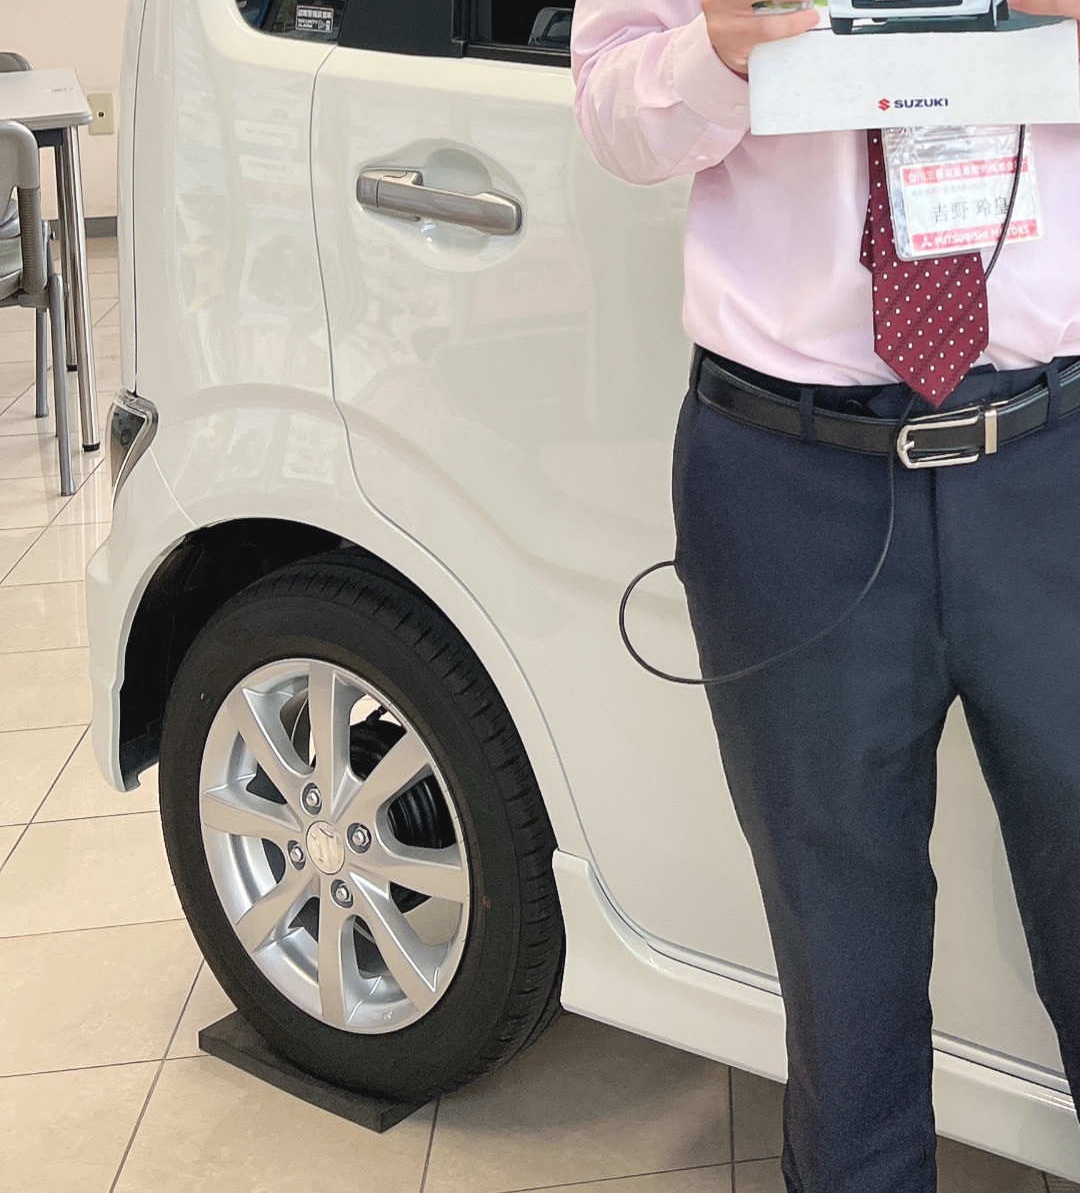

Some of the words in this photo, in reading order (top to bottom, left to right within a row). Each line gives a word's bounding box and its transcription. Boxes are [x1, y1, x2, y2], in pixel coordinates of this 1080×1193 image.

[894, 98, 949, 109] SUZUKI
[935, 227, 989, 246] MITSUBISHI
[991, 224, 1030, 239] MTORS
